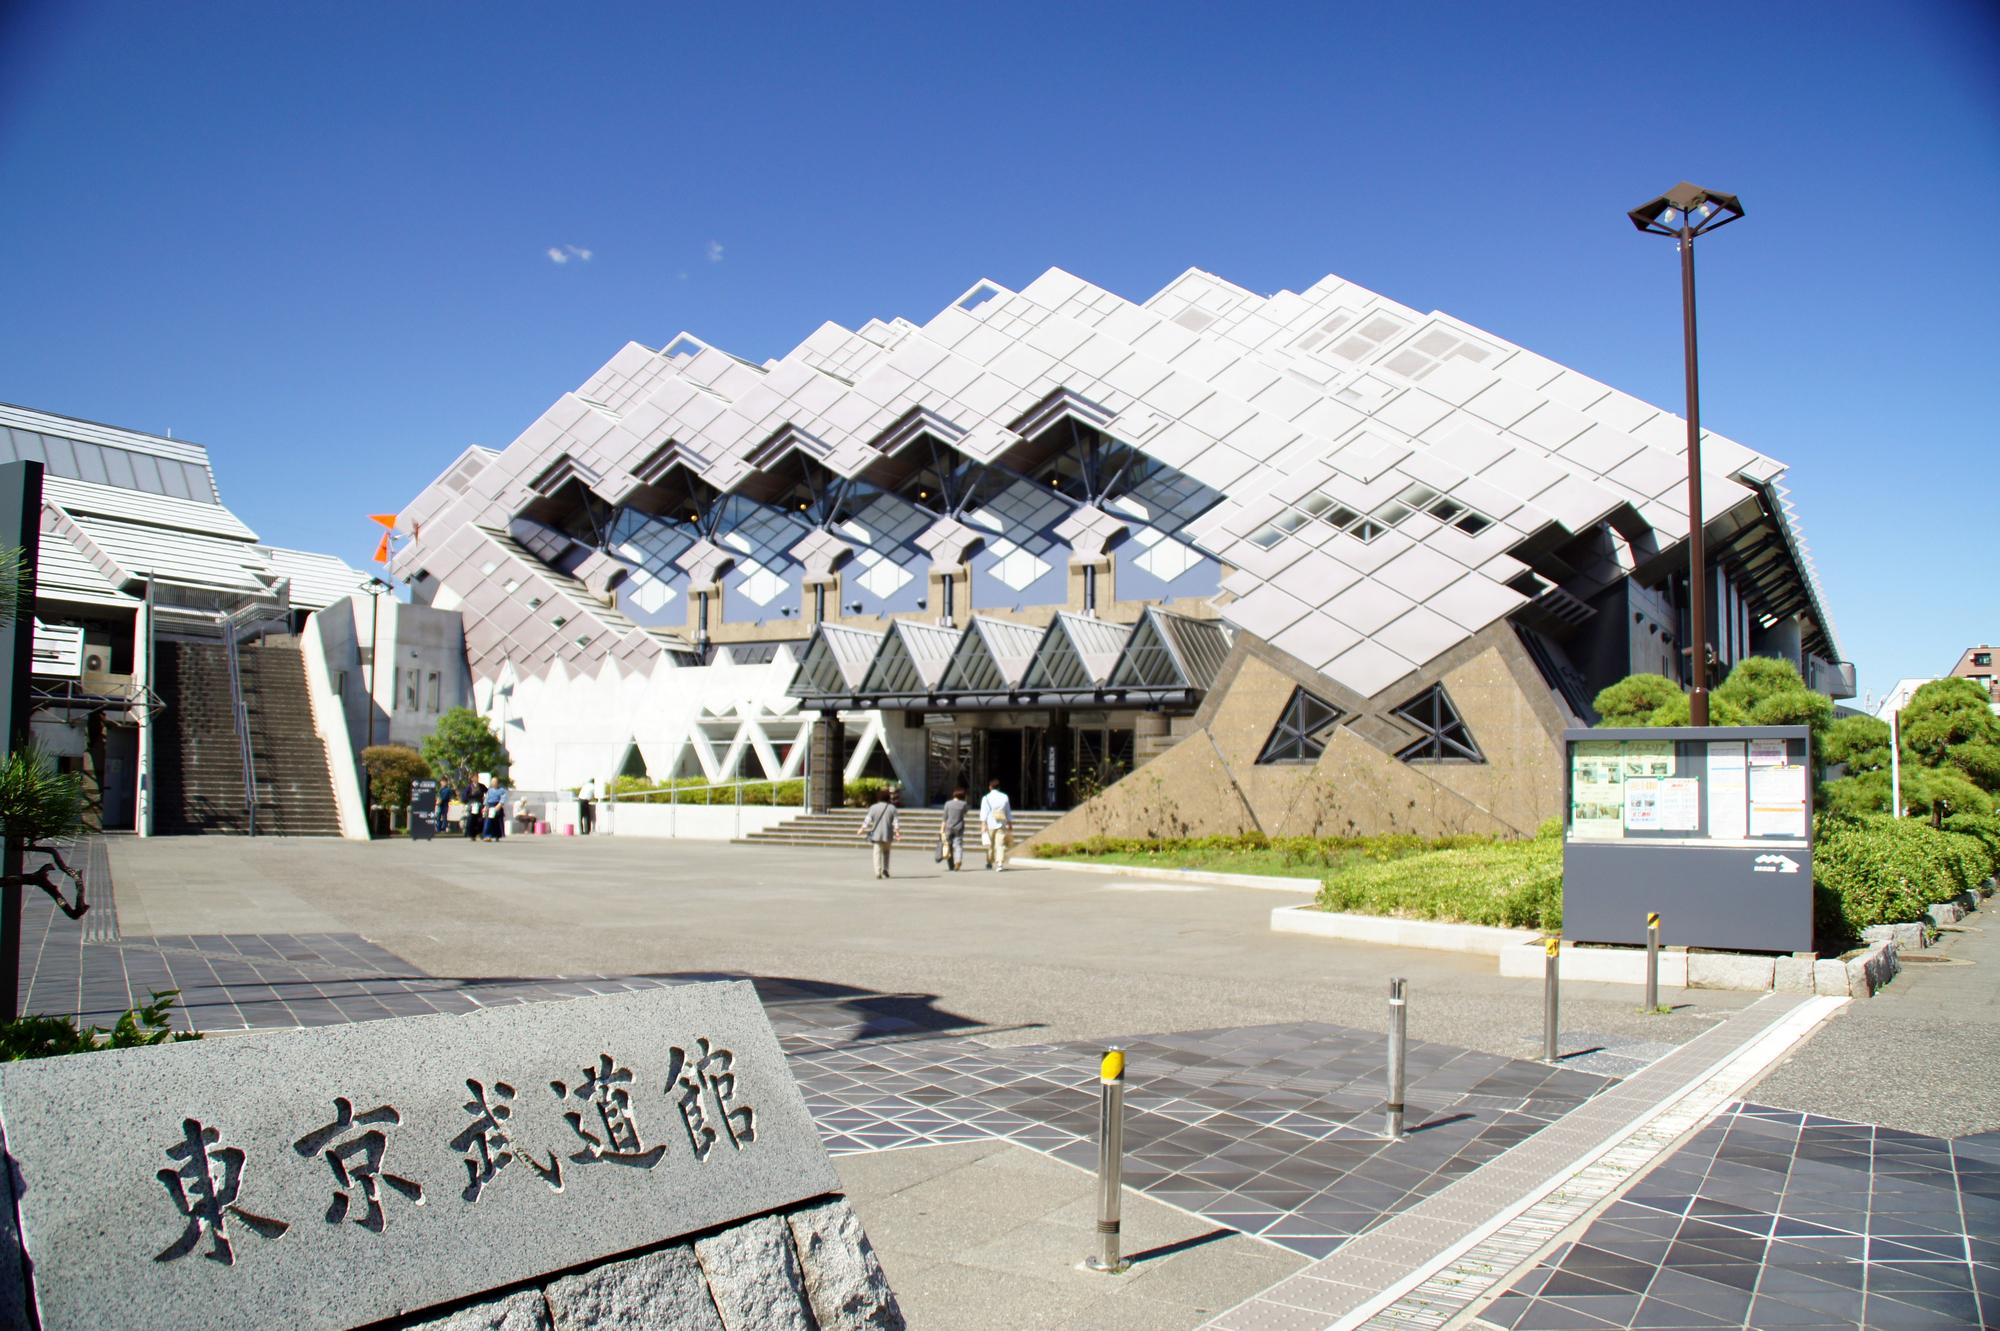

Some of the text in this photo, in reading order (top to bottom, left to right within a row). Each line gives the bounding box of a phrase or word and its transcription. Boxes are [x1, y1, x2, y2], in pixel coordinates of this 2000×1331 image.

[154, 1037, 757, 1267] 東京武道館
